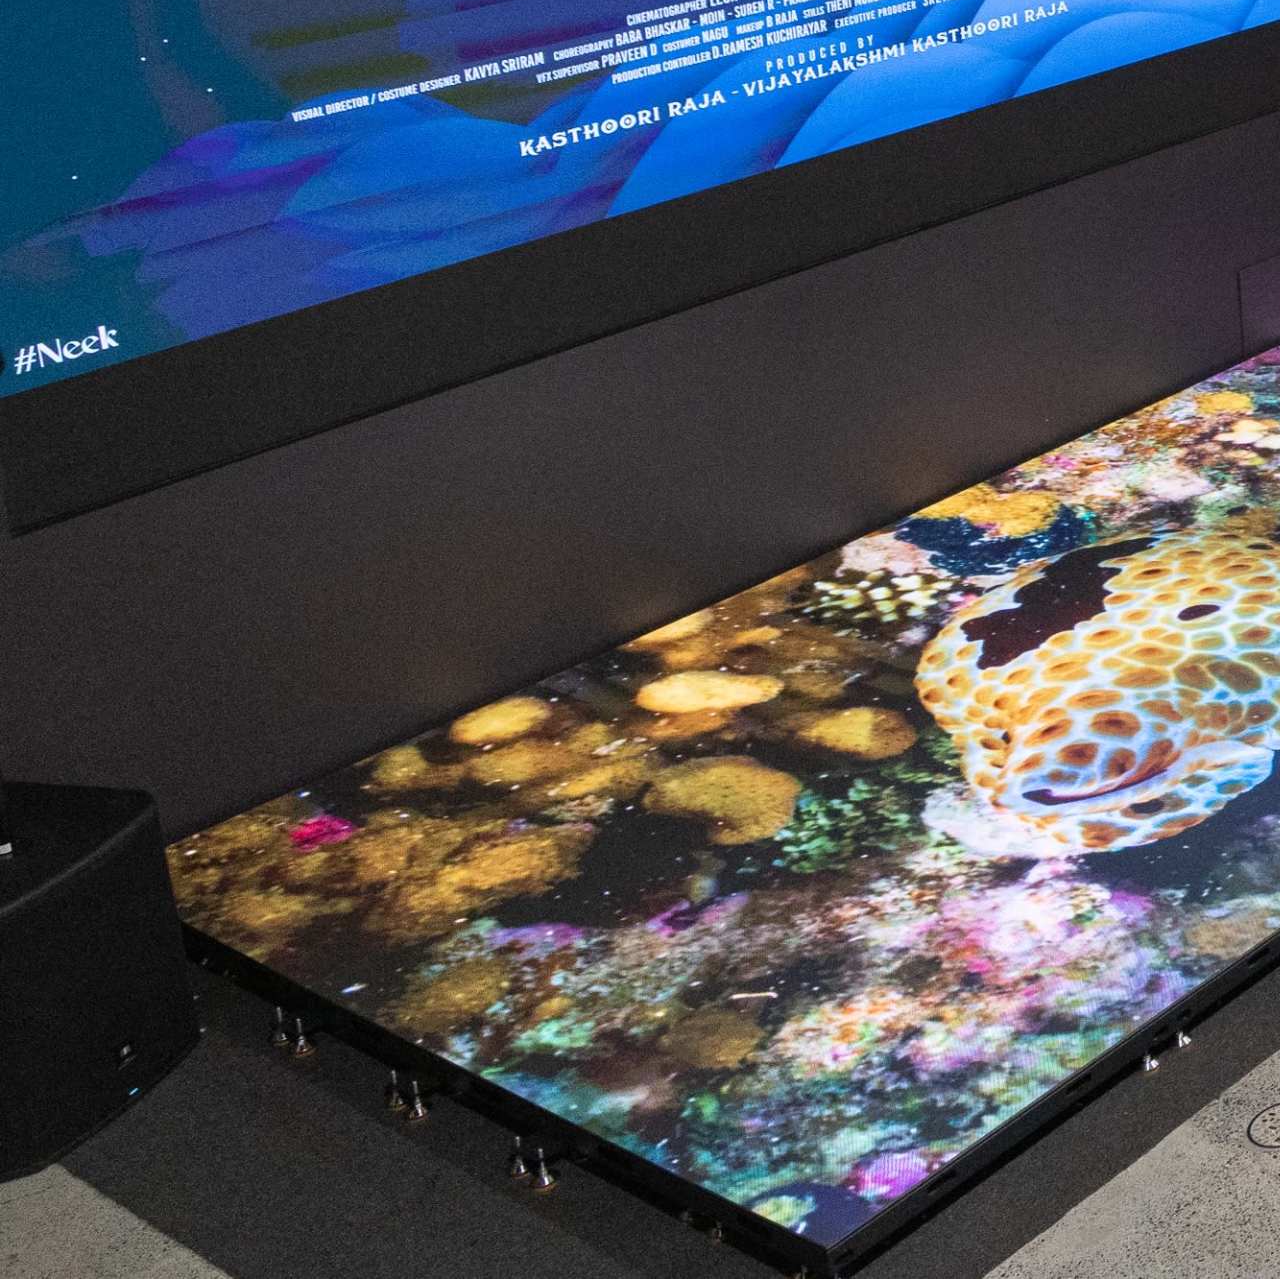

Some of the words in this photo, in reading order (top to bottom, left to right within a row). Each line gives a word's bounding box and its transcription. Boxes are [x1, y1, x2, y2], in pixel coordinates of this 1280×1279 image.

[292, 106, 325, 122] VISUAL
[325, 95, 370, 116] DIRECTOR
[378, 84, 418, 103] COSTUME
[420, 74, 462, 93] DESIGNER
[463, 63, 501, 84] KAVYA
[501, 51, 545, 74] SRIRAM
[553, 38, 614, 62] CHOREOGRAPHY
[615, 30, 643, 48] BABA
[644, 17, 690, 40] BHASKAR
[699, 11, 726, 28] MOIN
[734, 2, 765, 19] SUREN
[519, 106, 661, 157] KASTHOORI
[668, 89, 726, 118] RAJA
[742, 43, 905, 98] VIJAYALAKSHMI
[912, 12, 1018, 53] KASTHOORI
[1024, 0, 1068, 23] RAJA
[536, 71, 552, 84] VFX
[552, 60, 600, 80] SUPERVISOR
[601, 47, 648, 68] PRAVEEN
[650, 43, 657, 56] D
[662, 36, 700, 53] COSTUMER
[702, 27, 729, 43] NAGU
[736, 21, 764, 35] MAKEUP
[766, 15, 773, 28] B
[775, 10, 798, 25] RAJA
[803, 5, 825, 19] STILLS
[612, 64, 662, 85] PRODUCTION
[662, 51, 712, 72] CONTROLLER
[766, 19, 828, 46] KUCHIRAYAR
[834, 10, 876, 29] EXECUTIVE
[877, 0, 917, 18] PRODUCER
[766, 41, 848, 72] PRODUCED
[857, 34, 875, 49] BY
[13, 325, 119, 375] #Neek
